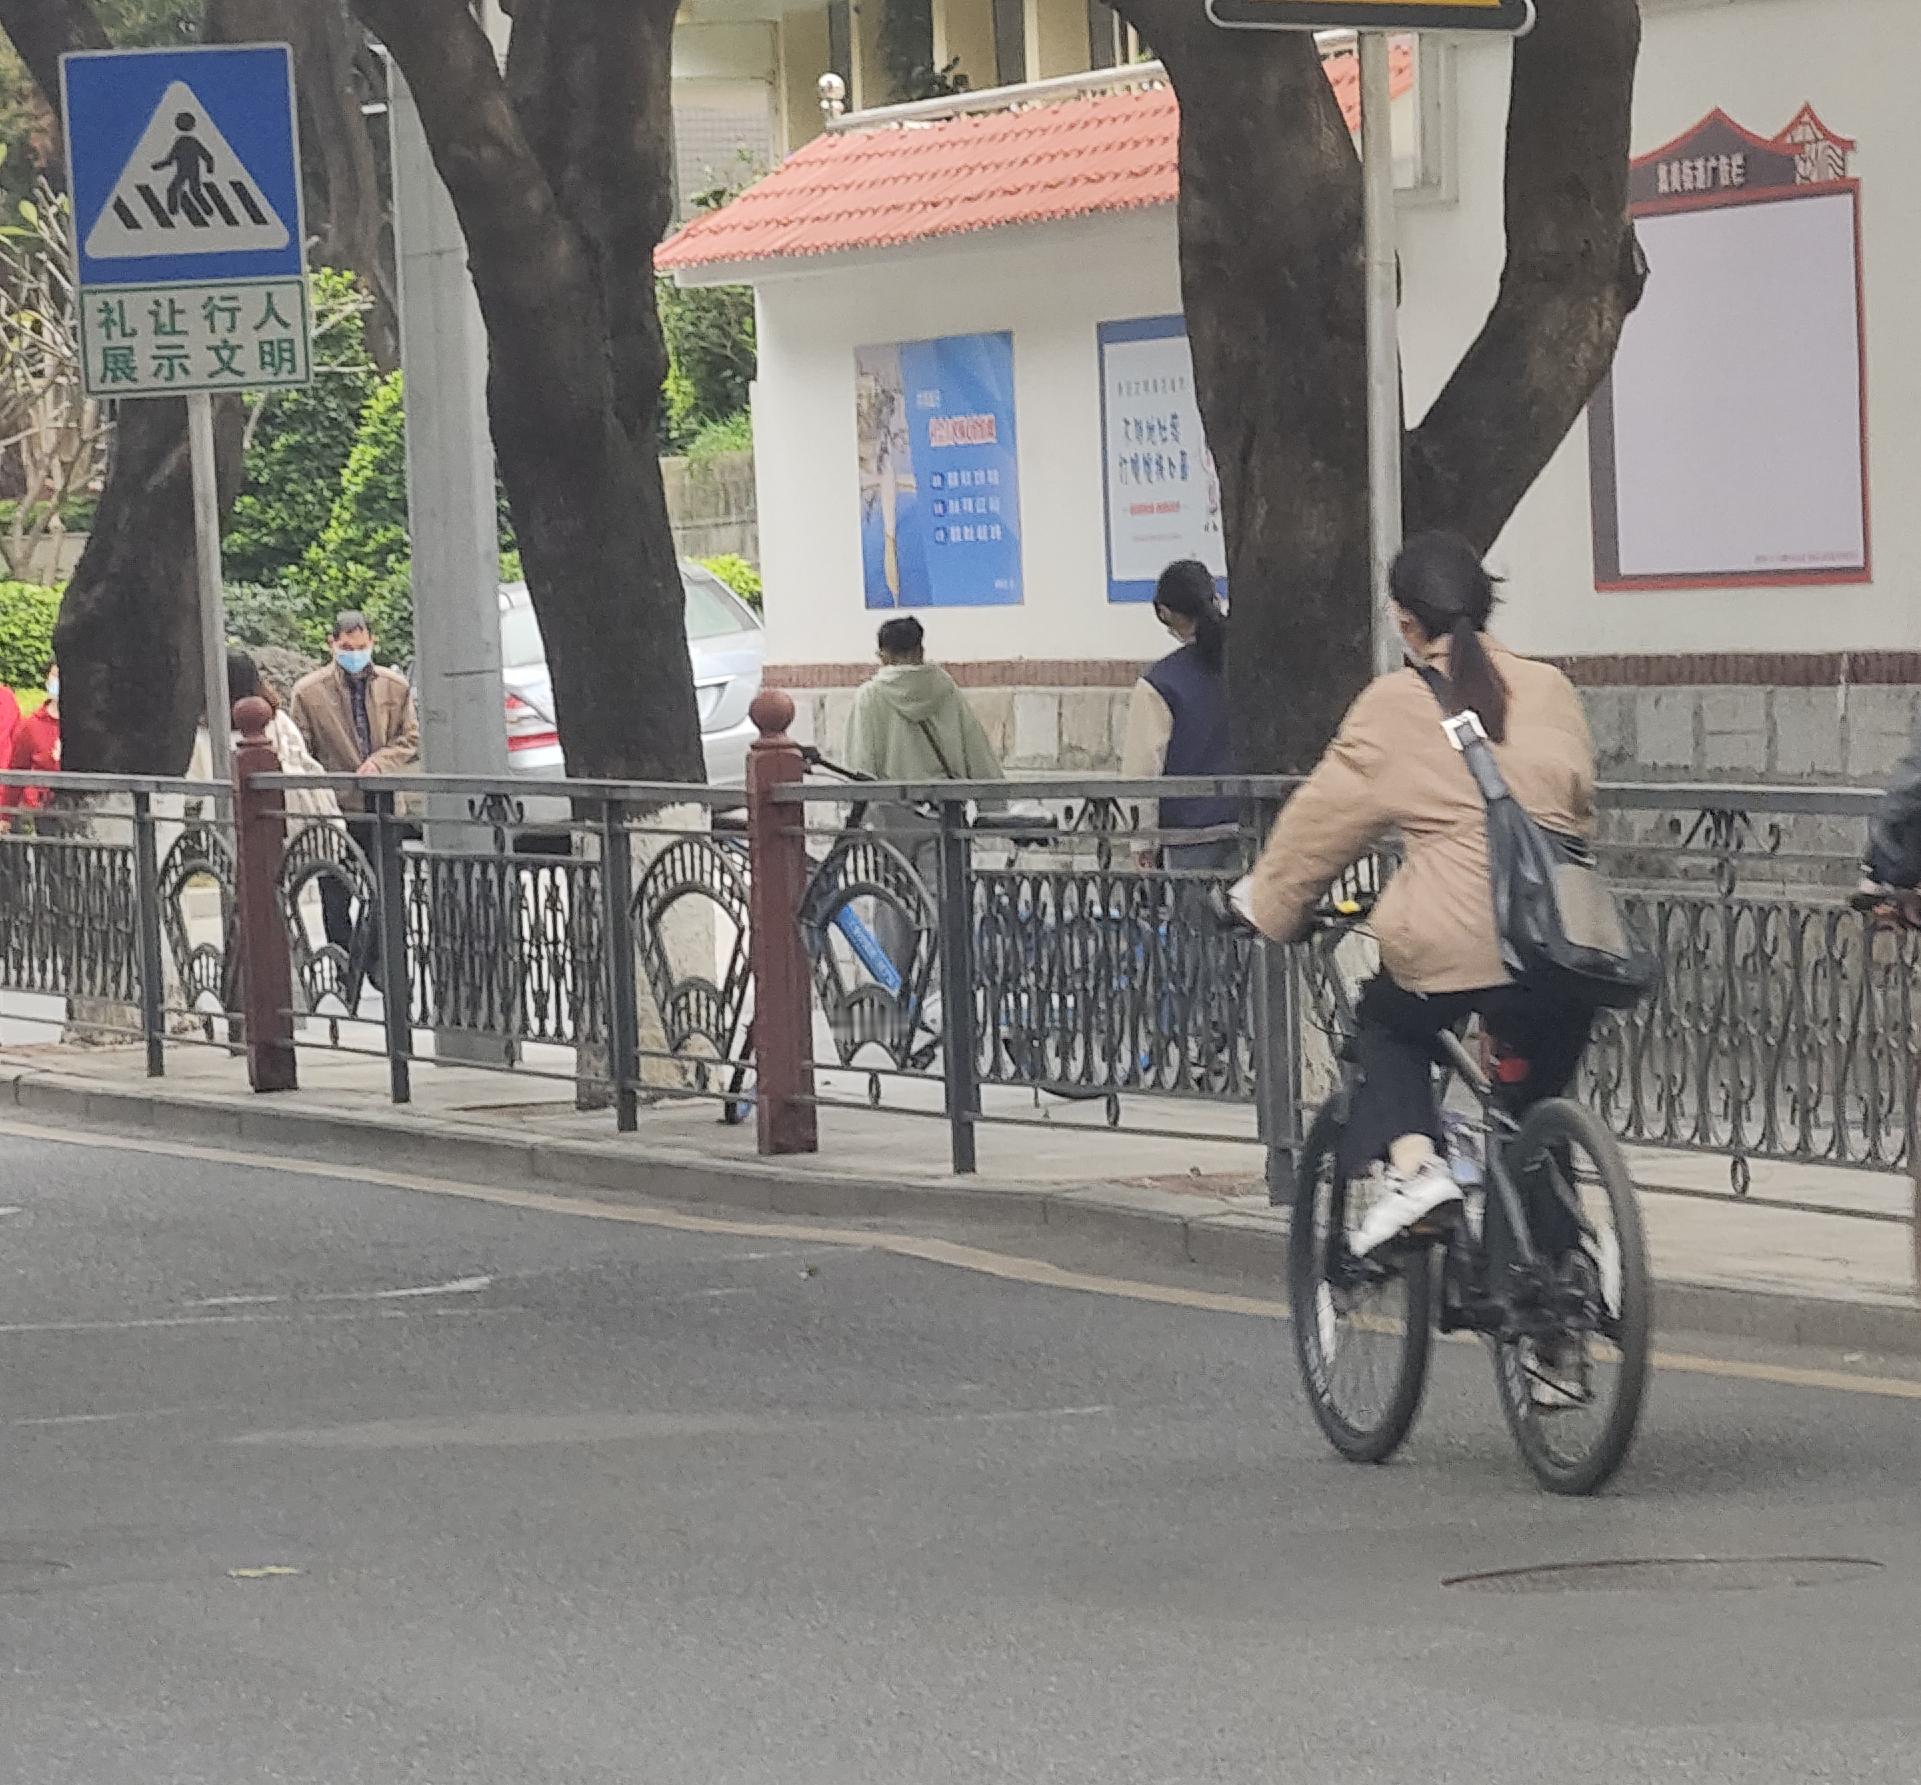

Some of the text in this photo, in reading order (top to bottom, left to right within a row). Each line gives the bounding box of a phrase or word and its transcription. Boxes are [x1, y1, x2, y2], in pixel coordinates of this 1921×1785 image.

[97, 291, 291, 340] 礼让行人
[100, 338, 297, 383] 展示文明
